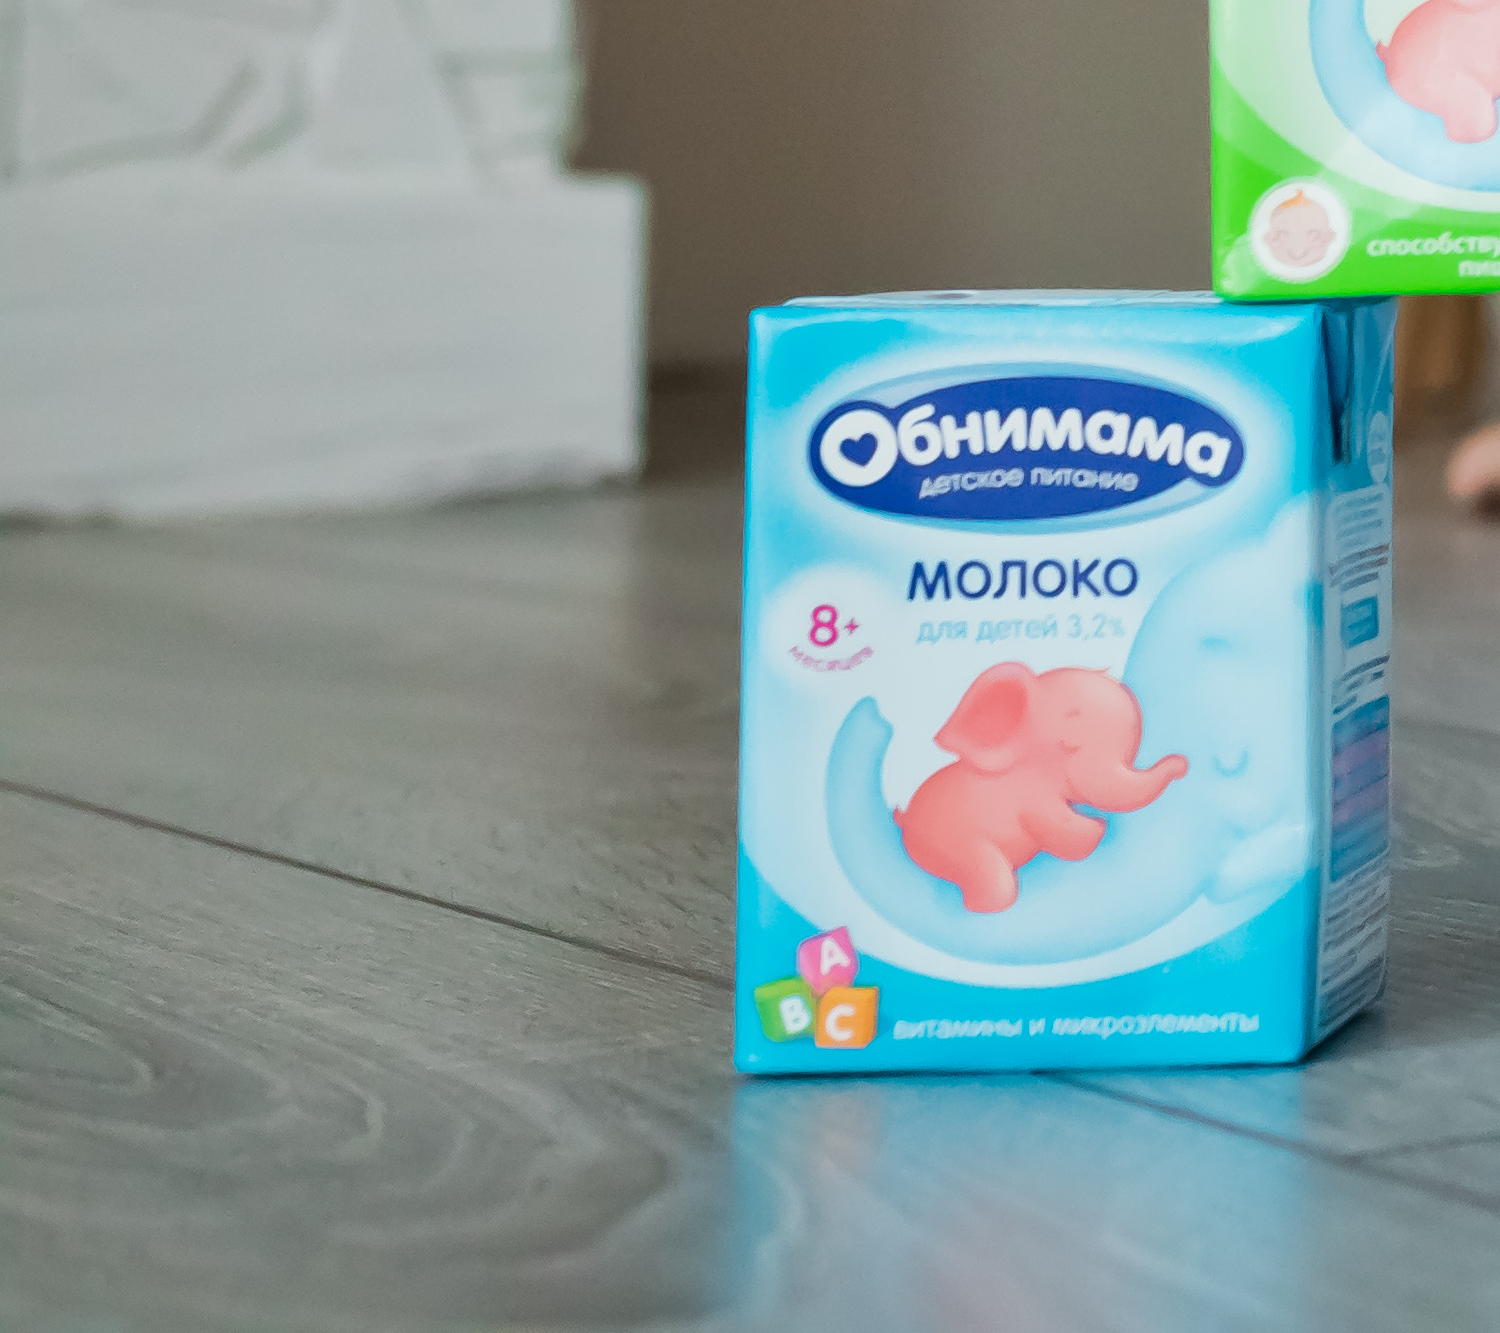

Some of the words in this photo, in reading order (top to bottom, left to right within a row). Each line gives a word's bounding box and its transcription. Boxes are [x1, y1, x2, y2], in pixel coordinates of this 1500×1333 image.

[821, 404, 1231, 486] Обнимама
[919, 467, 1023, 498] детское
[1031, 467, 1140, 492] питание
[908, 558, 1138, 601] МОЛОКО
[808, 604, 859, 647] 8+
[915, 620, 968, 645] для
[976, 614, 1058, 643] детей
[817, 936, 851, 971] A
[780, 997, 810, 1033] B
[826, 1005, 856, 1041] C
[1030, 1017, 1045, 1035] и
